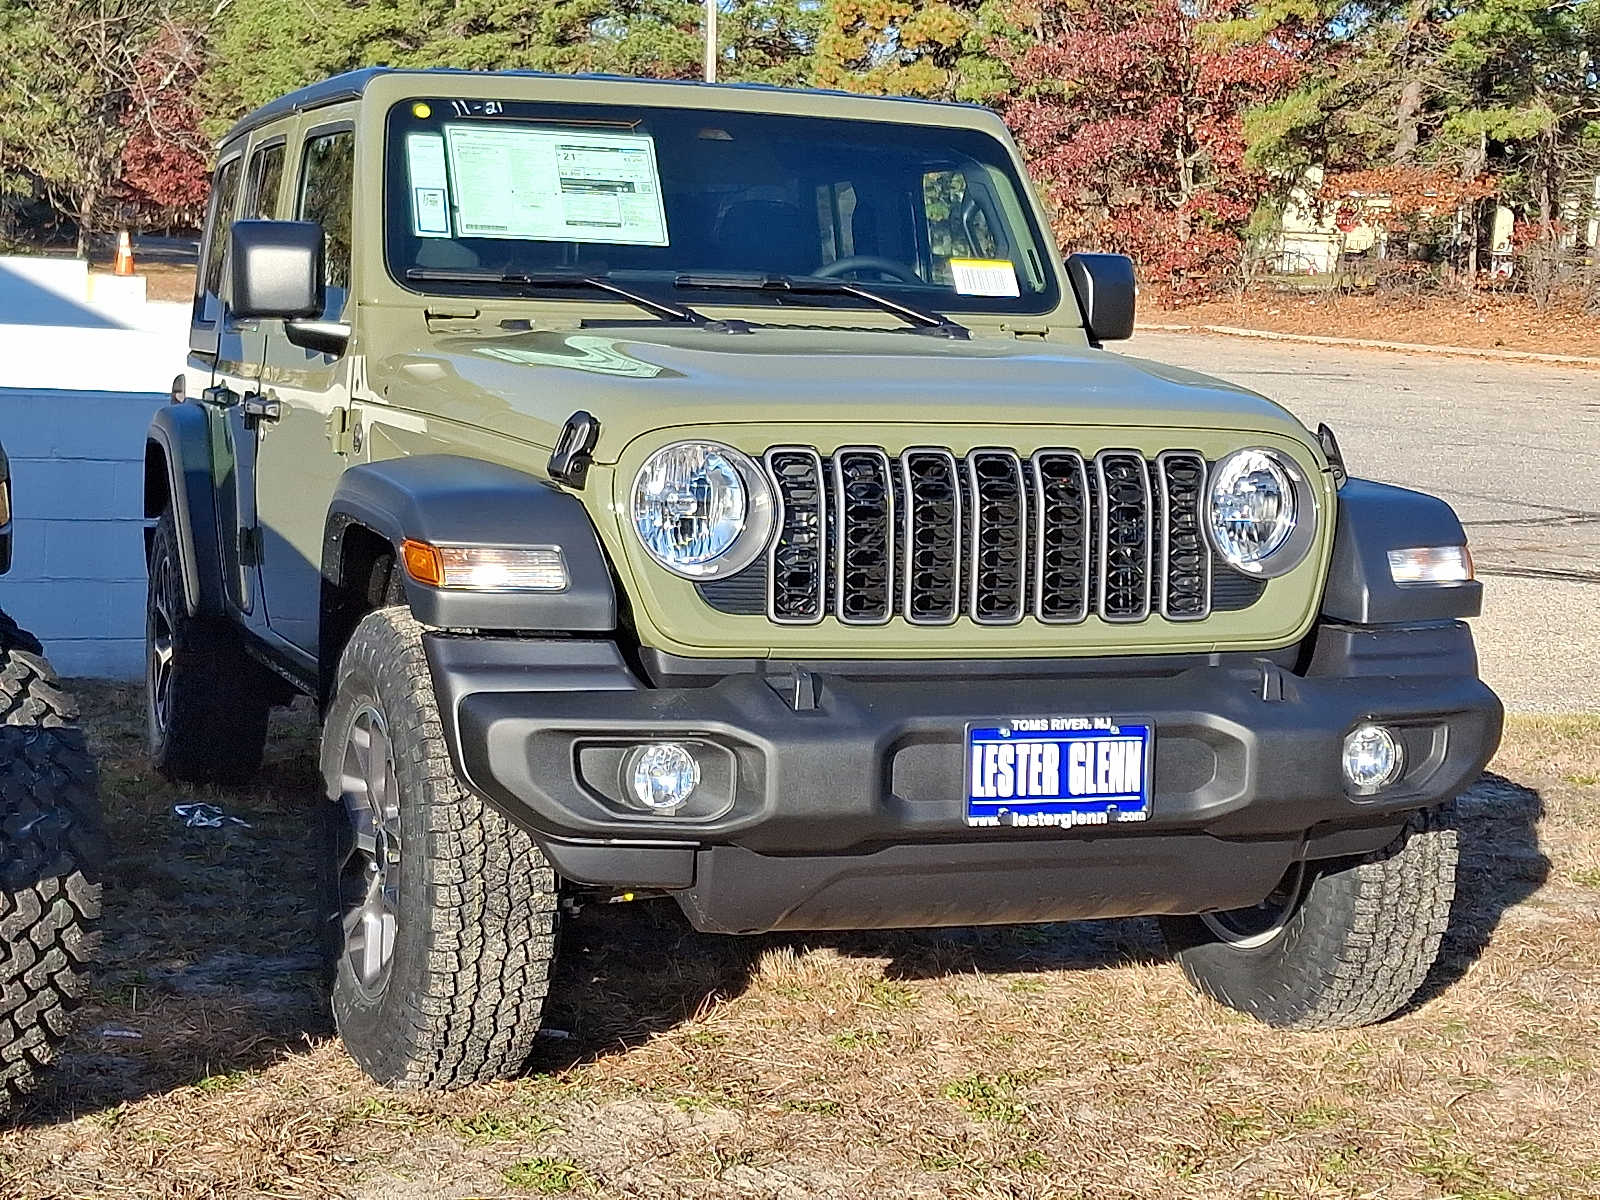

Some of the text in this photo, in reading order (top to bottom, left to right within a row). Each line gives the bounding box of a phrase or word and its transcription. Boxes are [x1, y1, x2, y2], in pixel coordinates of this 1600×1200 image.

[1011, 719, 1049, 731] TOMS
[1094, 717, 1112, 730] NJ
[972, 740, 1142, 797] LESTER GLENN
